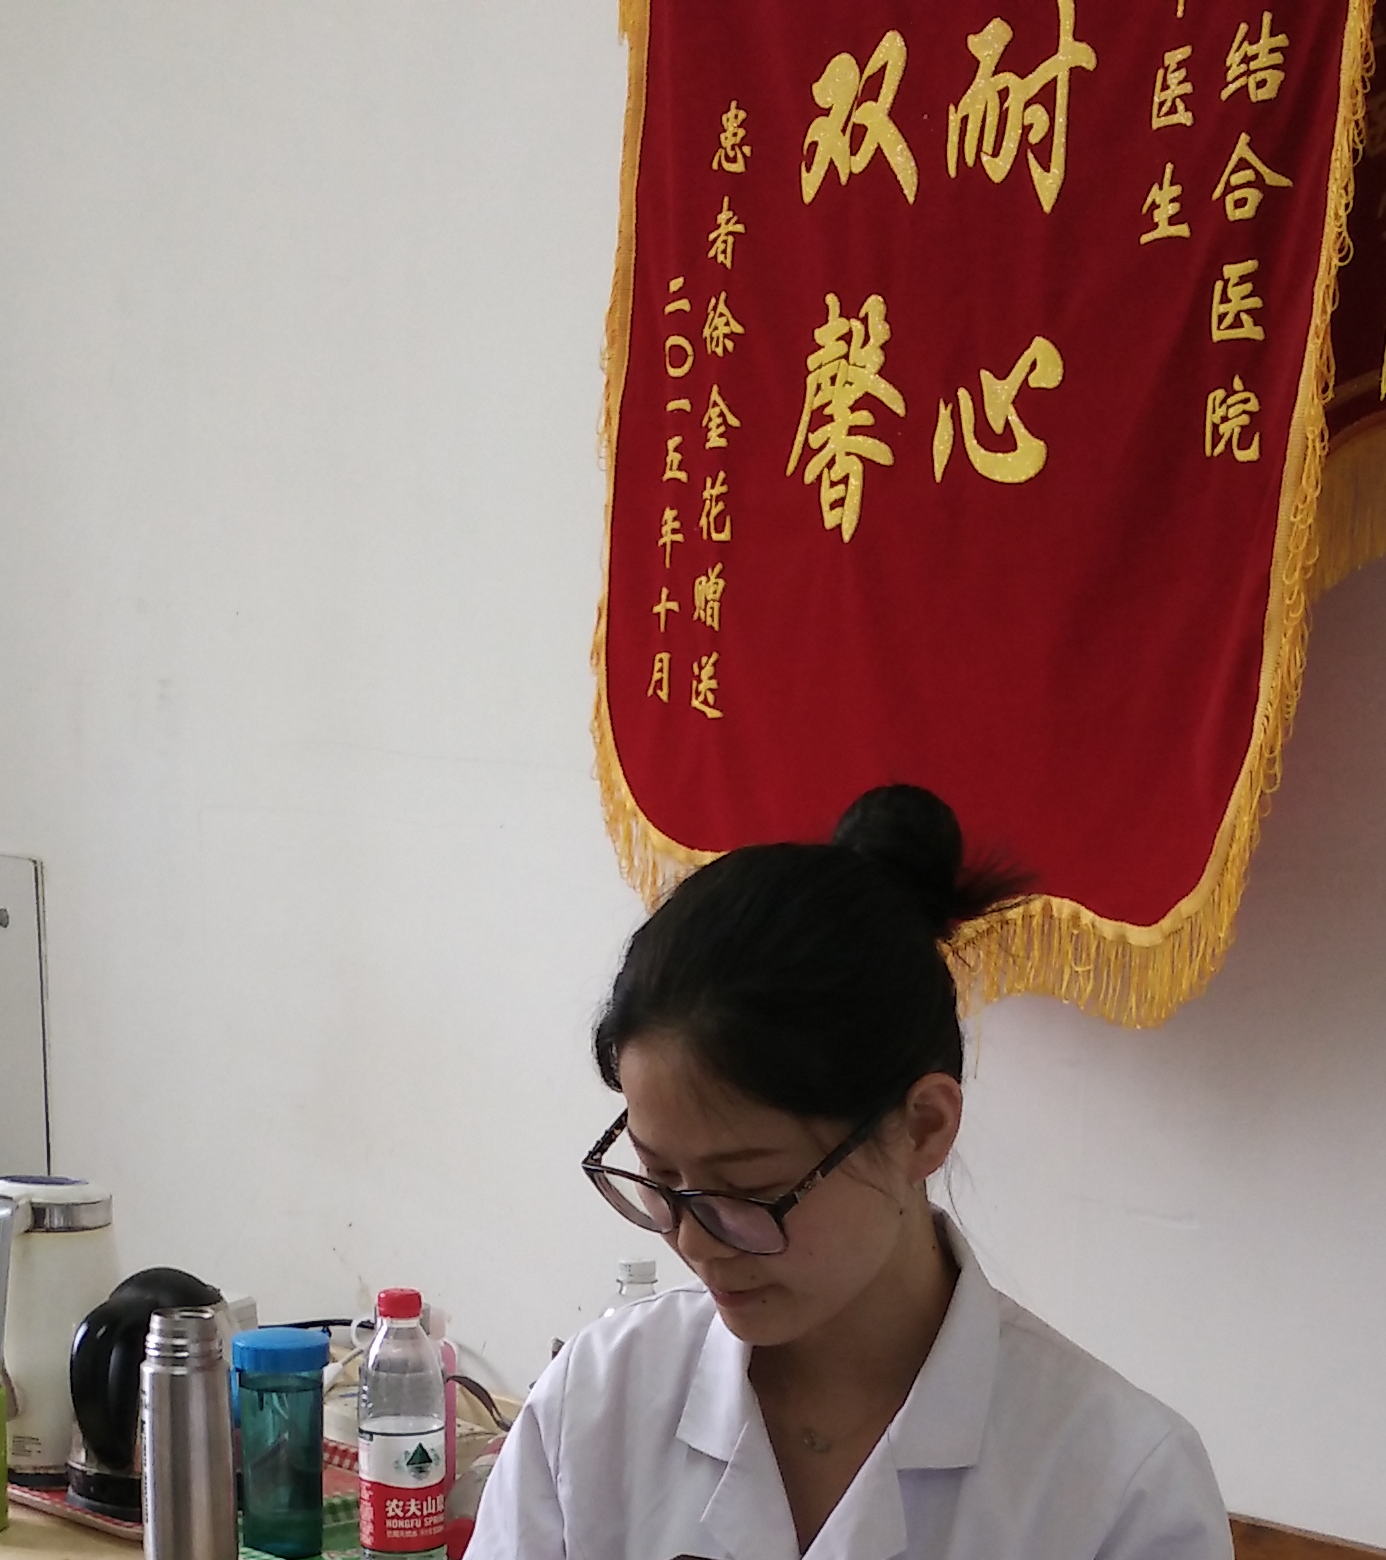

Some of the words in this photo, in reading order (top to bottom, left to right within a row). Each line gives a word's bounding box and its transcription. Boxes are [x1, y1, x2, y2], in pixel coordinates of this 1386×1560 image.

[786, 30, 919, 544] 双馨
[932, 0, 1097, 484] 耐心
[1139, 0, 1194, 245] 医生
[1204, 11, 1294, 462] 结合医院
[690, 101, 753, 719] 患者徐金花赠送
[386, 1518, 421, 1528] NONGFU
